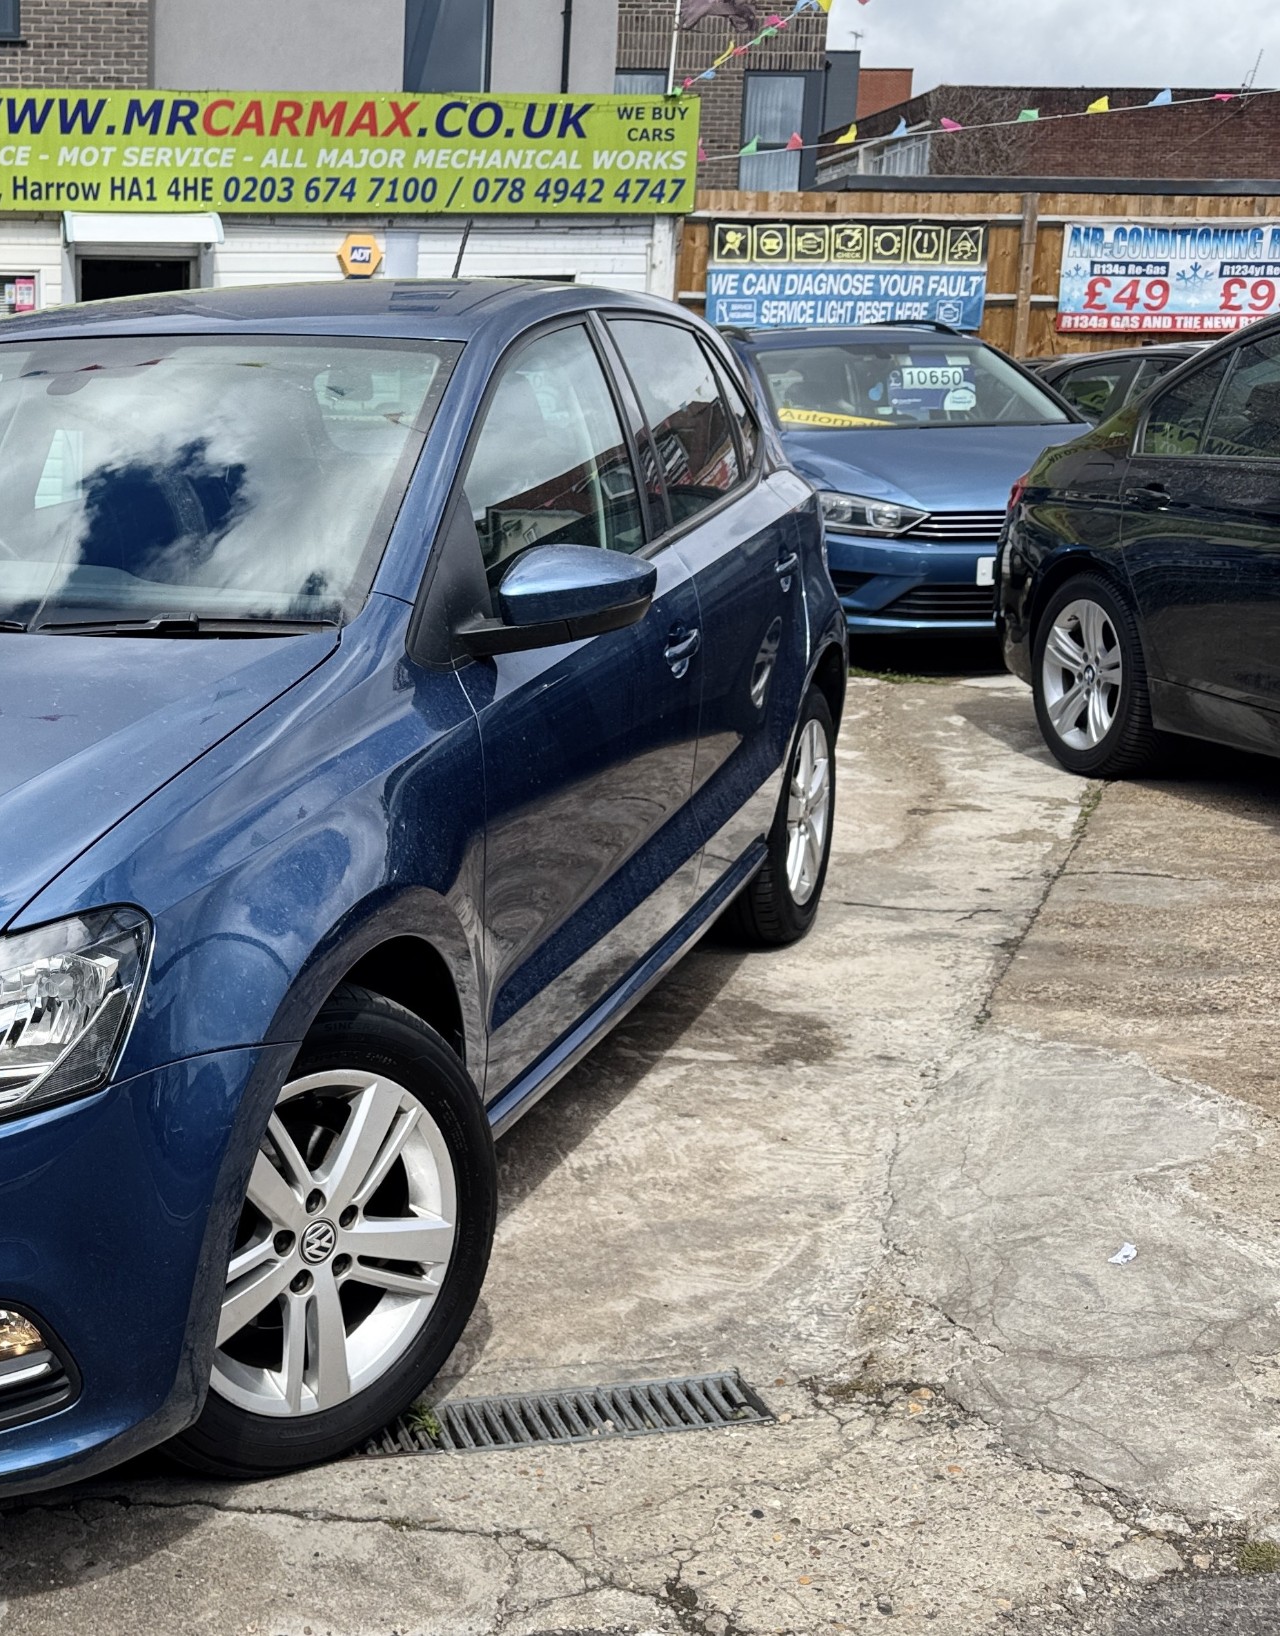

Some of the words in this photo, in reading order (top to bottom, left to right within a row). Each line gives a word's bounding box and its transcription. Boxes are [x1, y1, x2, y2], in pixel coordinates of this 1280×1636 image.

[617, 106, 646, 120] WE
[652, 107, 689, 121] BUY
[627, 127, 675, 142] CARS
[57, 146, 114, 167] MOT
[122, 146, 236, 168] SERVICE
[261, 148, 306, 168] ALL
[316, 148, 404, 169] MAJOR
[413, 148, 582, 170] MECHANICAL
[592, 149, 687, 170] WORKS
[12, 176, 100, 202] Harrow
[110, 177, 157, 202] HA1
[167, 177, 213, 202] 4HE
[224, 176, 294, 202] 0203
[304, 176, 357, 202] 674
[368, 176, 438, 203] 7100
[448, 176, 464, 206] /
[472, 177, 525, 203] 078
[534, 178, 604, 204] 4942
[613, 178, 686, 204] 4747
[351, 248, 371, 262] ADT
[1094, 264, 1126, 275] R134a
[1128, 264, 1166, 276] Re-Gas
[1223, 264, 1264, 276] R1234yf
[711, 274, 740, 295] WE
[743, 274, 780, 296] CAN
[784, 274, 874, 296] DIAGNOSE
[880, 275, 924, 296] YOUR
[927, 276, 980, 296] FAULT
[1083, 277, 1170, 311] £49
[1220, 278, 1280, 311] £9
[760, 300, 814, 324] SERVICE
[816, 300, 854, 324] LIGHT
[856, 301, 892, 323] RESET
[894, 302, 928, 322] HERE
[1062, 316, 1108, 328] R134a
[1111, 316, 1140, 328] GAS
[1143, 316, 1172, 328] AND
[1175, 316, 1200, 328] THE
[1204, 316, 1236, 328] NEW
[906, 370, 962, 386] 10650
